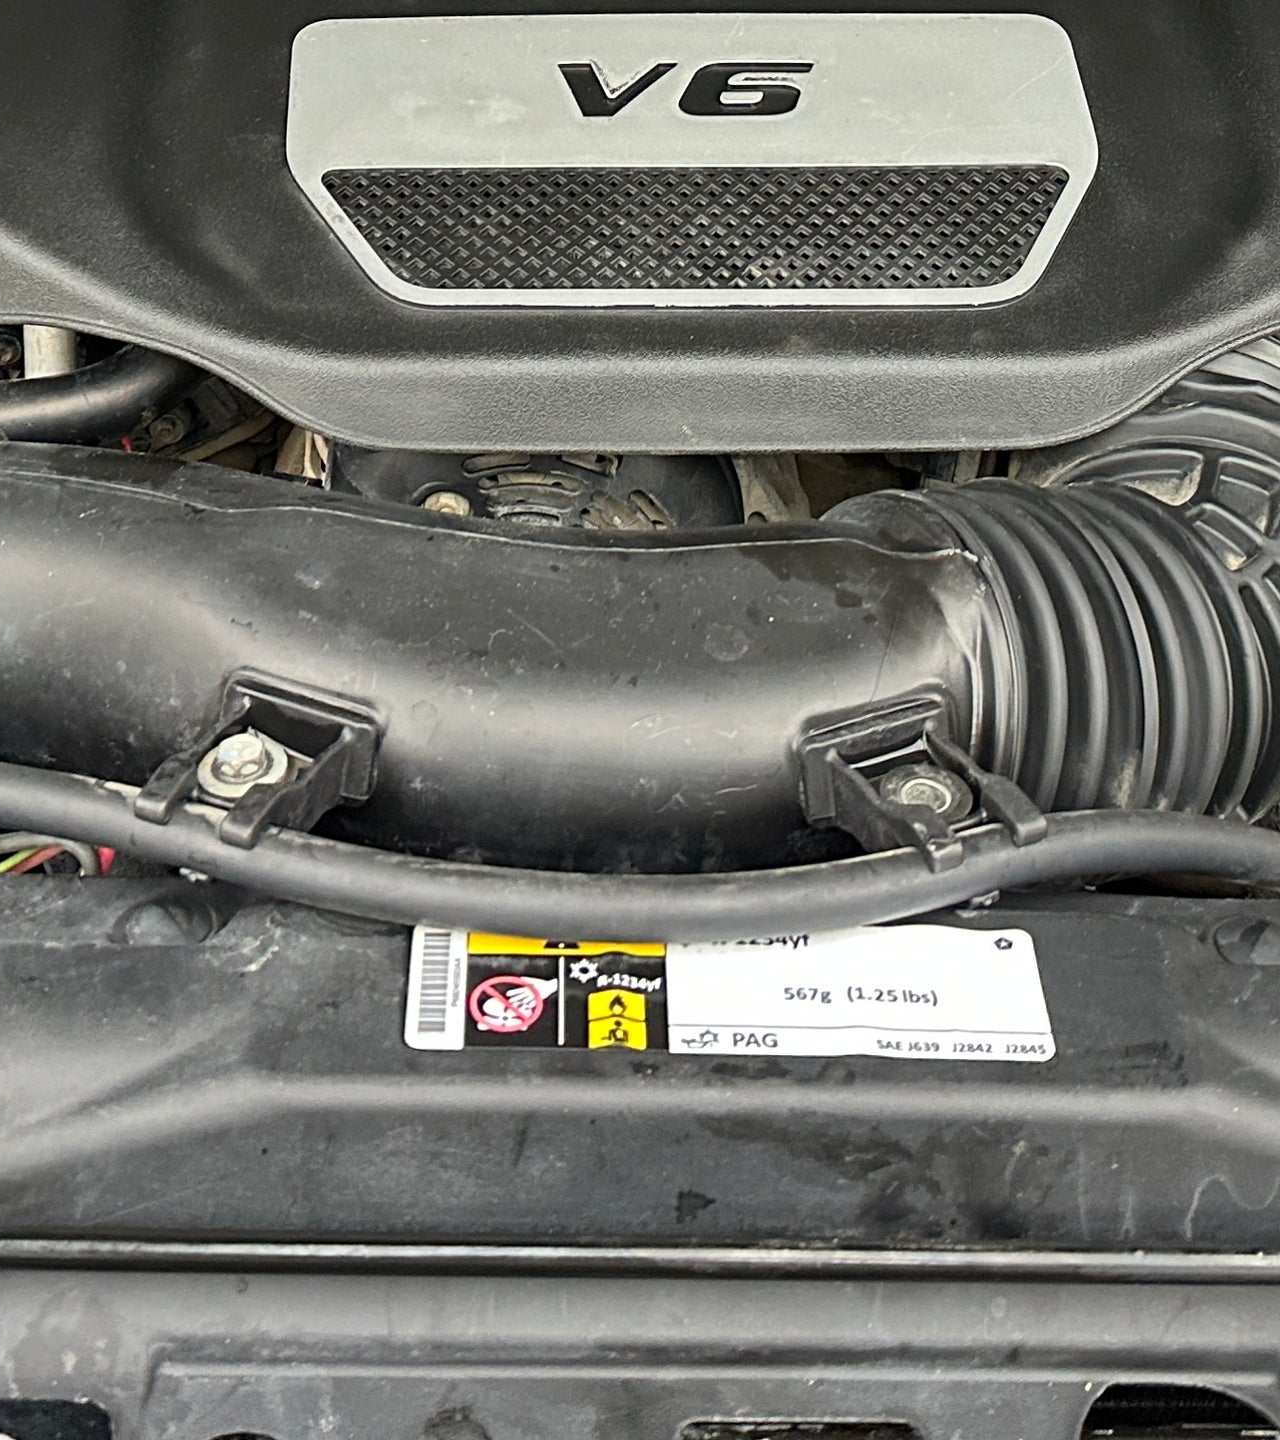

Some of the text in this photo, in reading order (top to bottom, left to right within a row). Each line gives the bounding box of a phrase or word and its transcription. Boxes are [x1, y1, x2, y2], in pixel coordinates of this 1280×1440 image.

[558, 61, 817, 118] V6
[596, 973, 663, 992] R-1234yf
[732, 1032, 779, 1048] PAG
[877, 1039, 903, 1051] SAE
[908, 1041, 940, 1053] J639
